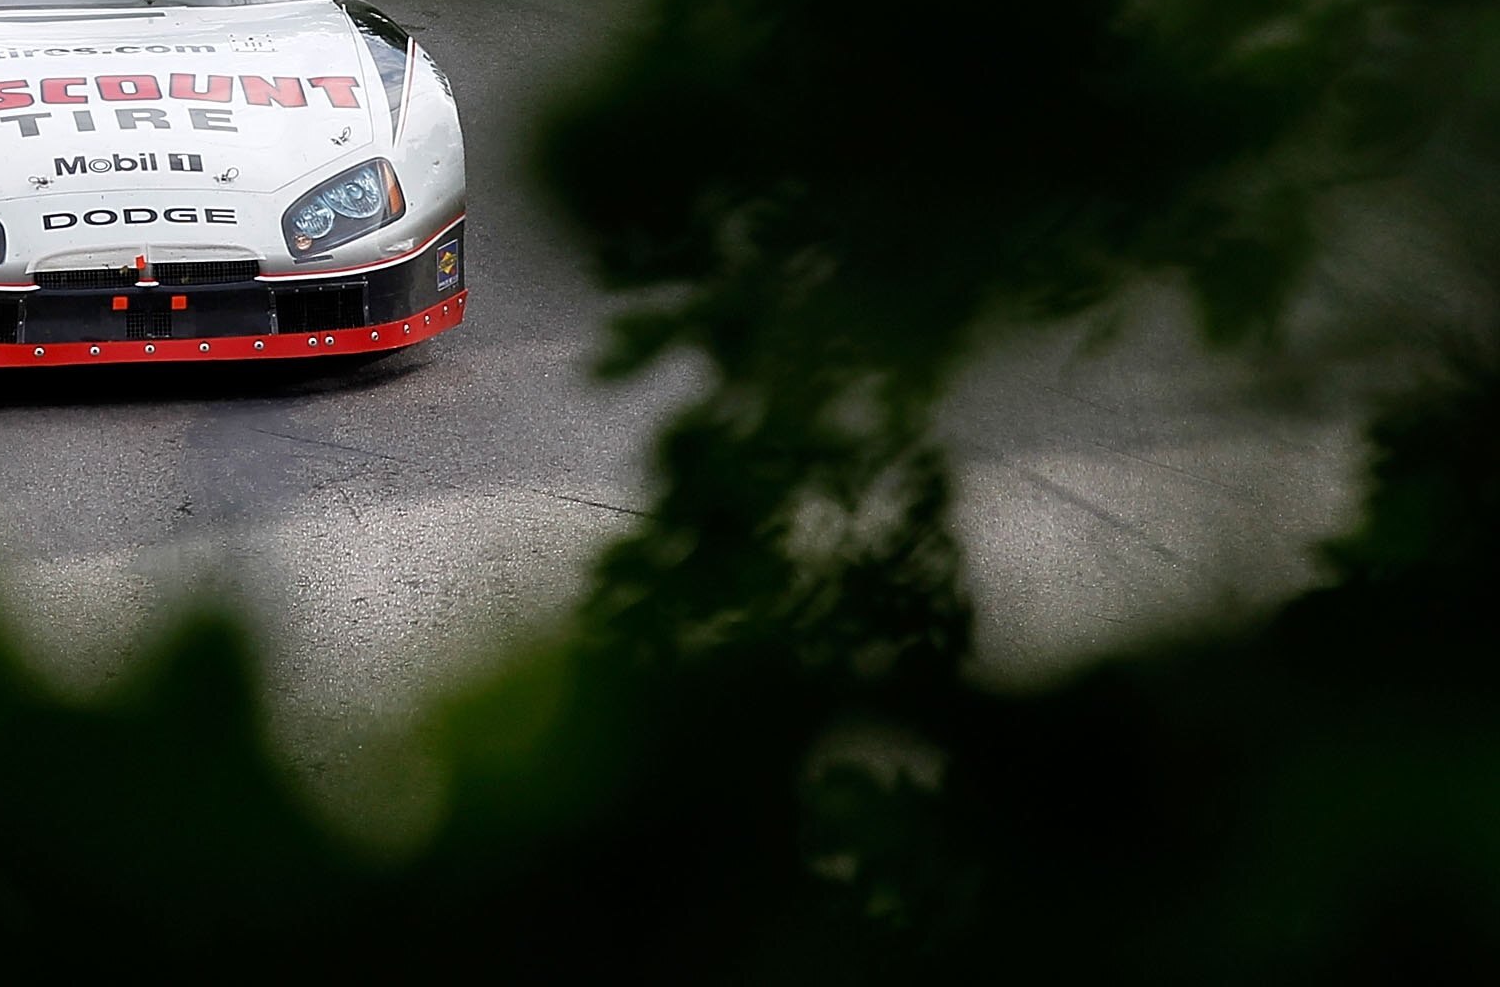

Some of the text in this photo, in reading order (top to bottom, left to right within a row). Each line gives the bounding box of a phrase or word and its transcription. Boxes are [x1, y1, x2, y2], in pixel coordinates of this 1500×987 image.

[0, 107, 238, 138] TIRE
[53, 152, 204, 177] Mobil 1
[42, 208, 239, 231] DODGE
